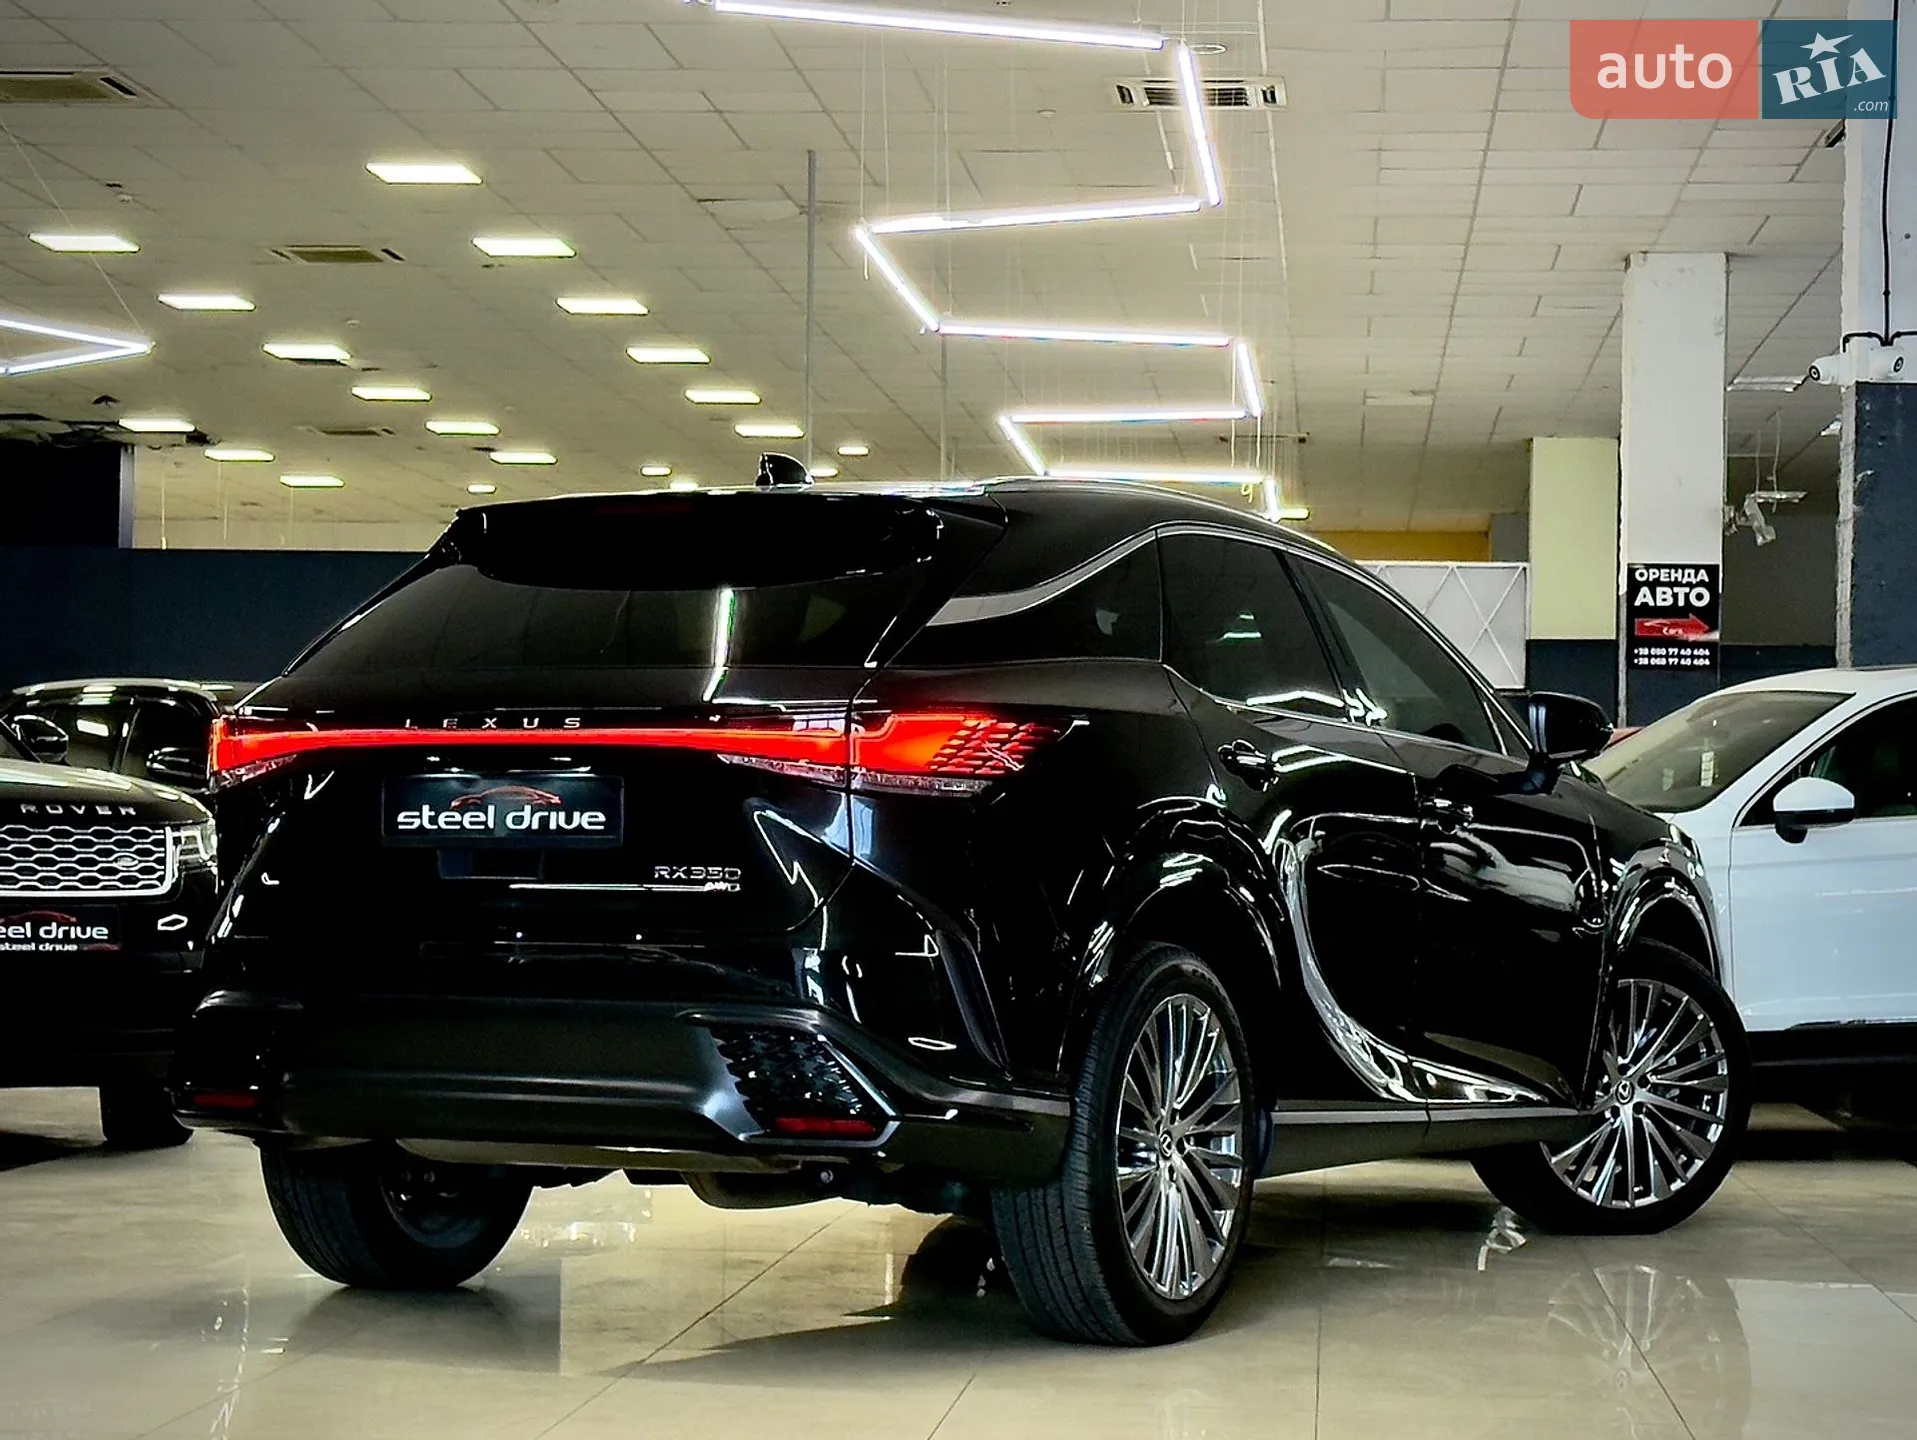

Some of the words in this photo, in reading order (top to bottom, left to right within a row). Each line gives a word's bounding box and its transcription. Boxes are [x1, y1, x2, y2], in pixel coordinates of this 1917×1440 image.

[1634, 568, 1710, 584] ОРЕНДА
[1633, 586, 1711, 607] АВТО
[404, 717, 582, 729] LEXUS
[20, 803, 136, 816] ROVER
[396, 804, 496, 830] steel
[505, 804, 607, 830] drive
[654, 865, 742, 880] RX350
[39, 921, 109, 940] drive
[38, 942, 78, 951] drive
